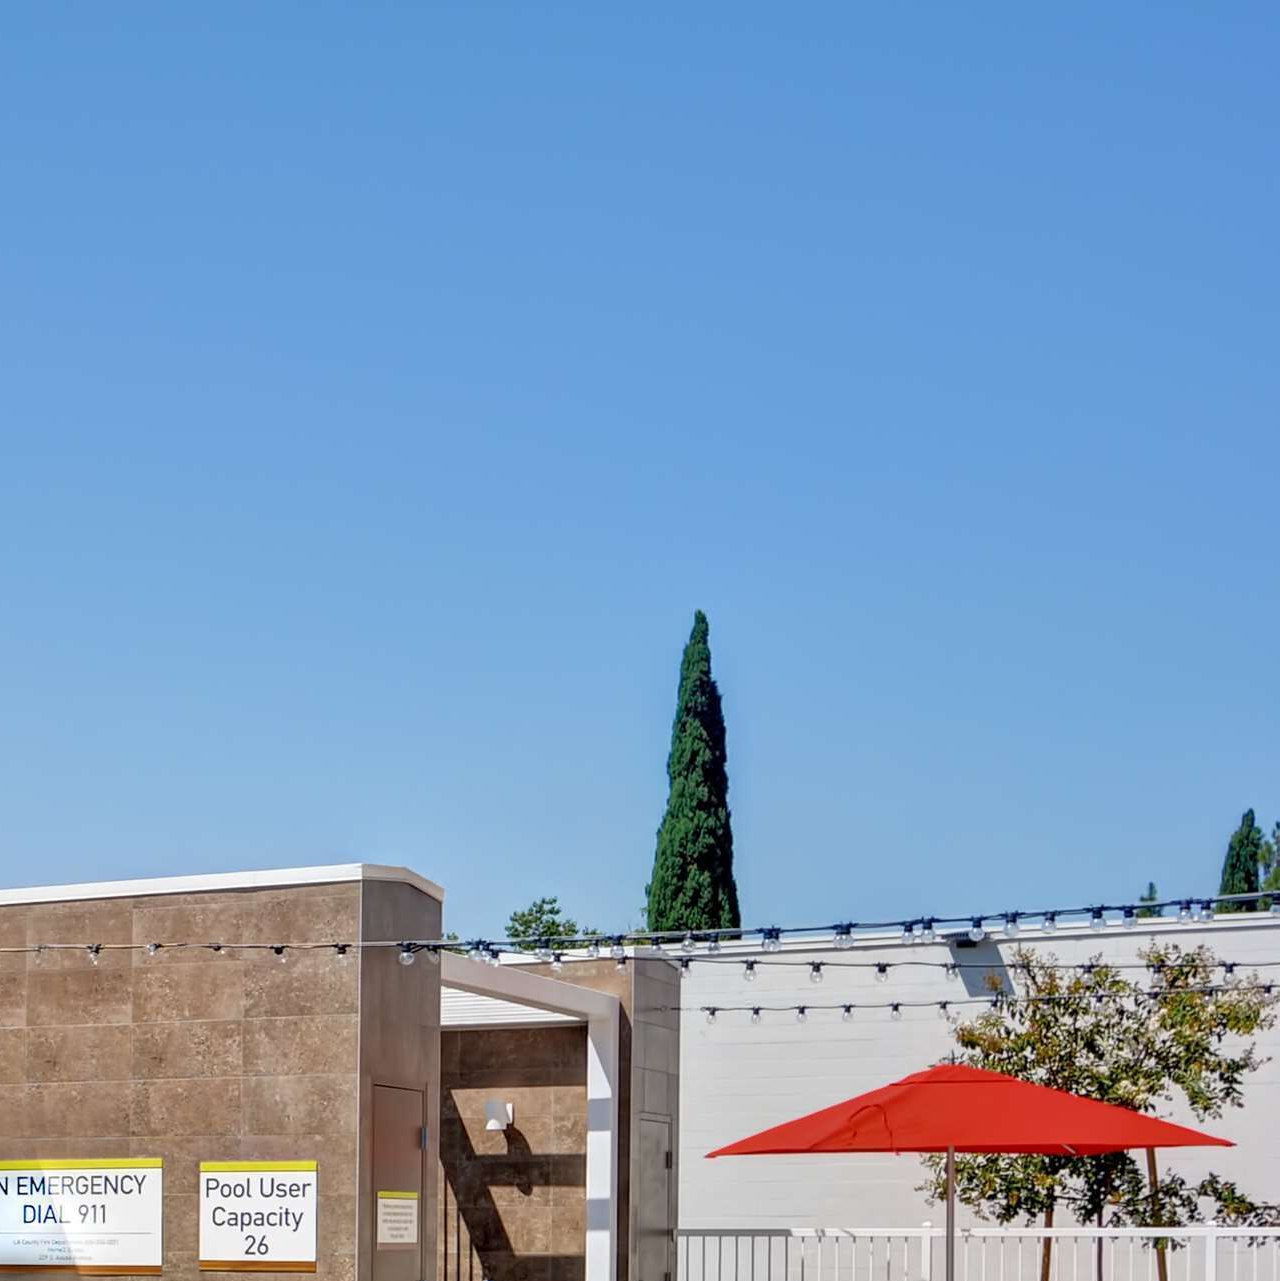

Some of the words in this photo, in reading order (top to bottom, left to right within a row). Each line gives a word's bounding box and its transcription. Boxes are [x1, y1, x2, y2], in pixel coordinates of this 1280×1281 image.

[17, 1175, 147, 1196] EMERGENCY
[205, 1178, 252, 1199] Pool
[260, 1178, 311, 1198] User
[23, 1204, 71, 1224] DIAL
[78, 1204, 106, 1224] 911
[212, 1206, 304, 1232] Capacity
[244, 1235, 269, 1255] 26
